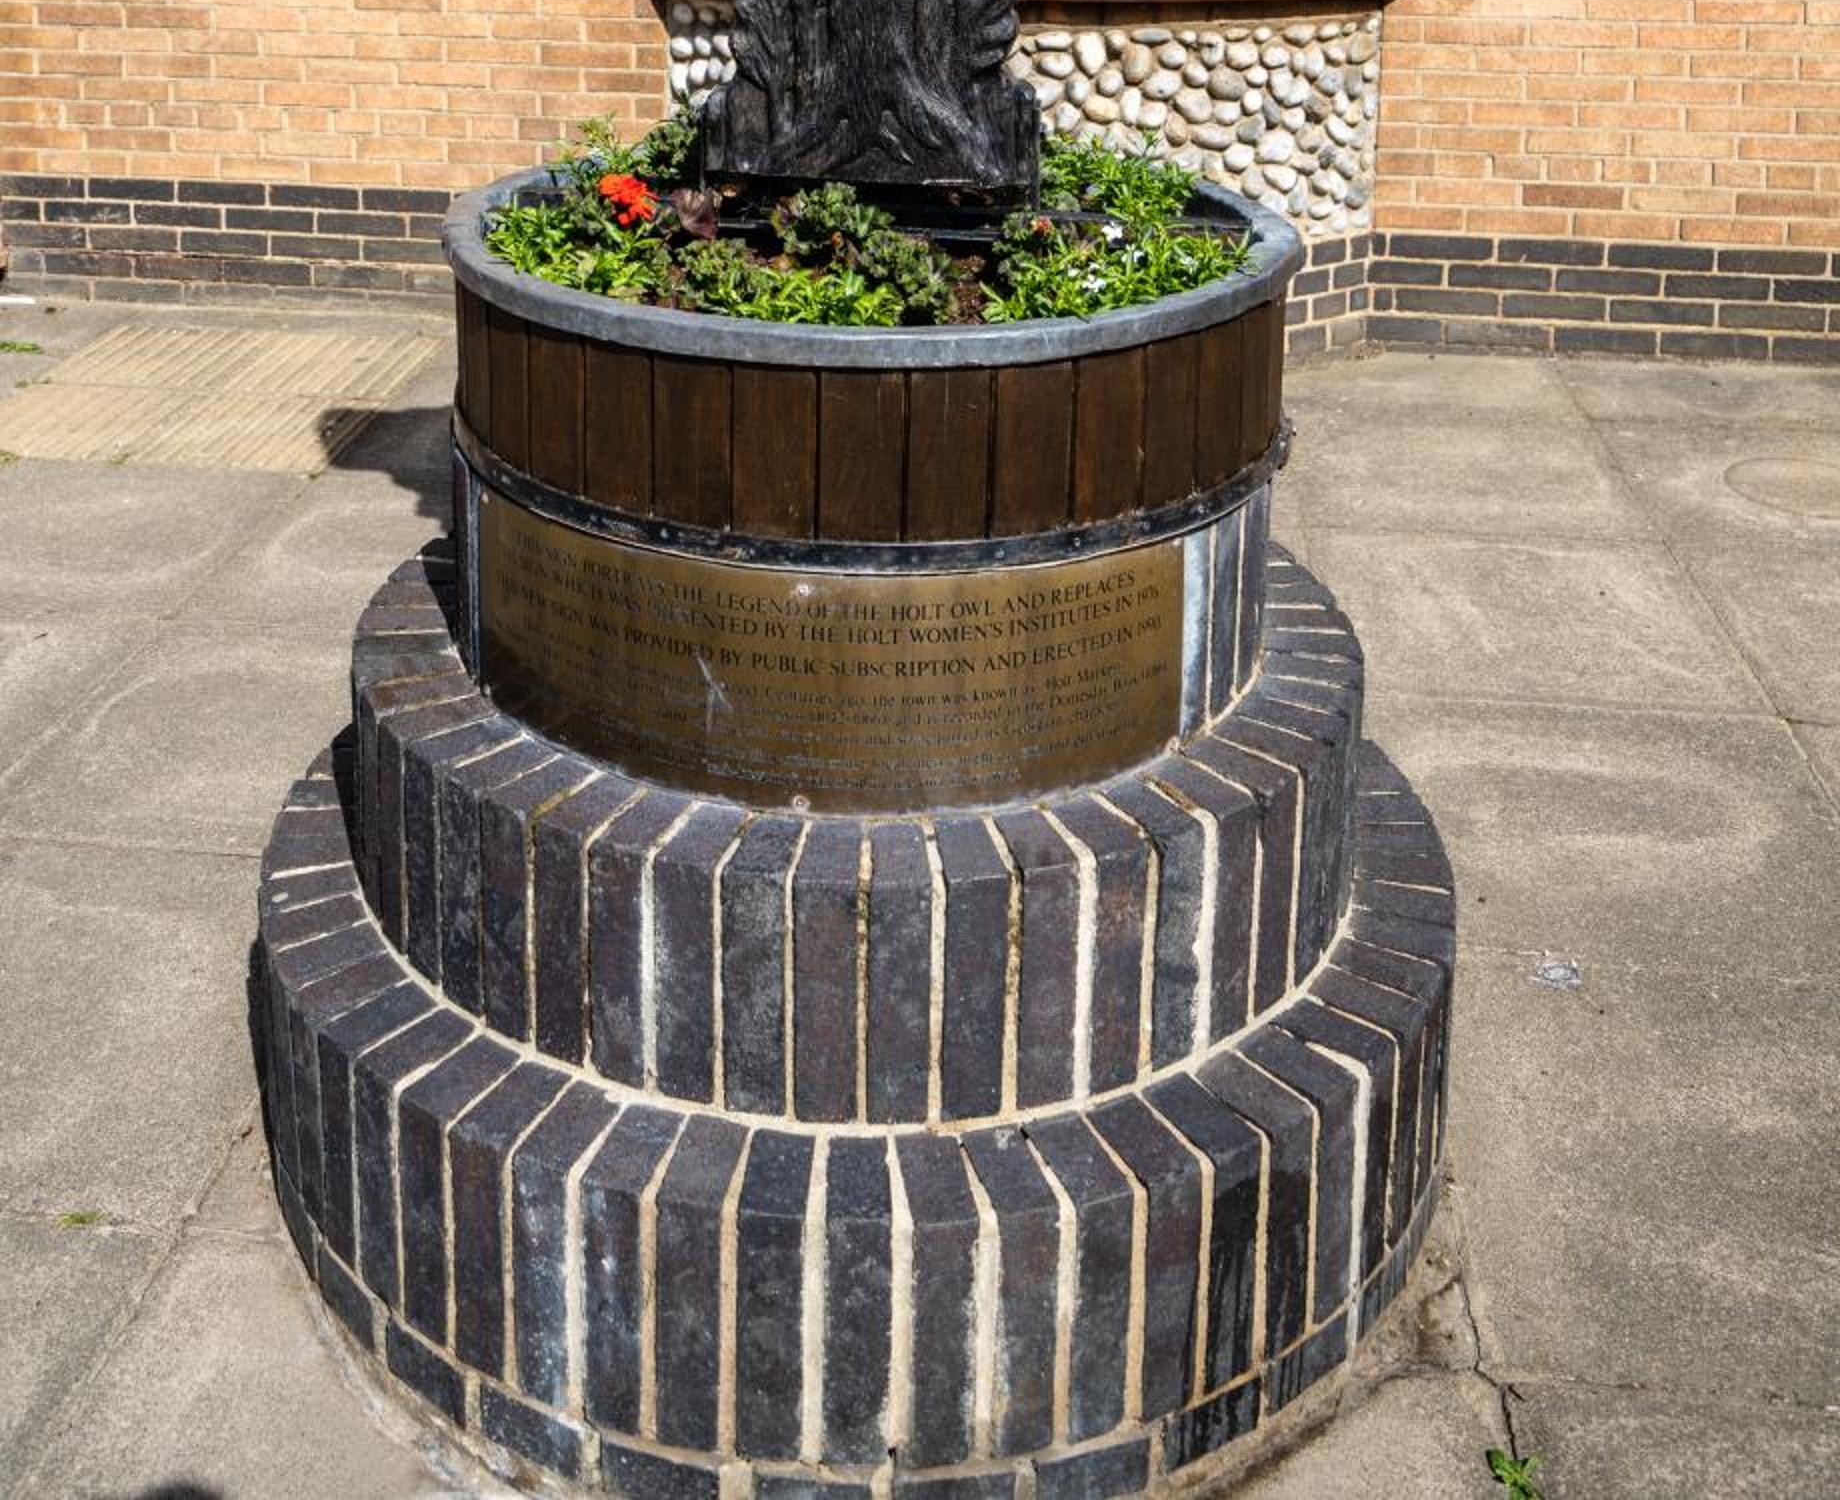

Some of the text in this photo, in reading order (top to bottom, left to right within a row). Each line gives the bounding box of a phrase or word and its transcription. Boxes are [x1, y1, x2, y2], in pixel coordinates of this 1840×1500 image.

[646, 595, 759, 636] PRESENTED
[765, 619, 790, 640] BY
[800, 624, 842, 642] THE
[848, 627, 899, 644] HOLT
[909, 621, 1003, 644] WOMEN'S
[1009, 601, 1112, 637] INSTITUTES
[1115, 593, 1133, 613] IN
[673, 581, 706, 602] THE
[716, 591, 801, 617] LEGEND
[807, 602, 832, 620] OF
[836, 603, 881, 621] THE
[891, 603, 945, 621] HOLT
[951, 599, 995, 619] OWL
[1004, 590, 1045, 613] AND
[1050, 570, 1136, 605] REPLACES
[624, 626, 714, 662] PROVIDED
[719, 647, 743, 668] BY
[750, 651, 817, 675] PUBLIC
[829, 658, 976, 677] SUBSCRIPTION
[983, 650, 1028, 673] AND
[1032, 631, 1113, 666] ERECTED
[1116, 625, 1133, 644] IN
[872, 690, 896, 708] the
[900, 693, 936, 708] town
[972, 684, 1018, 703] known
